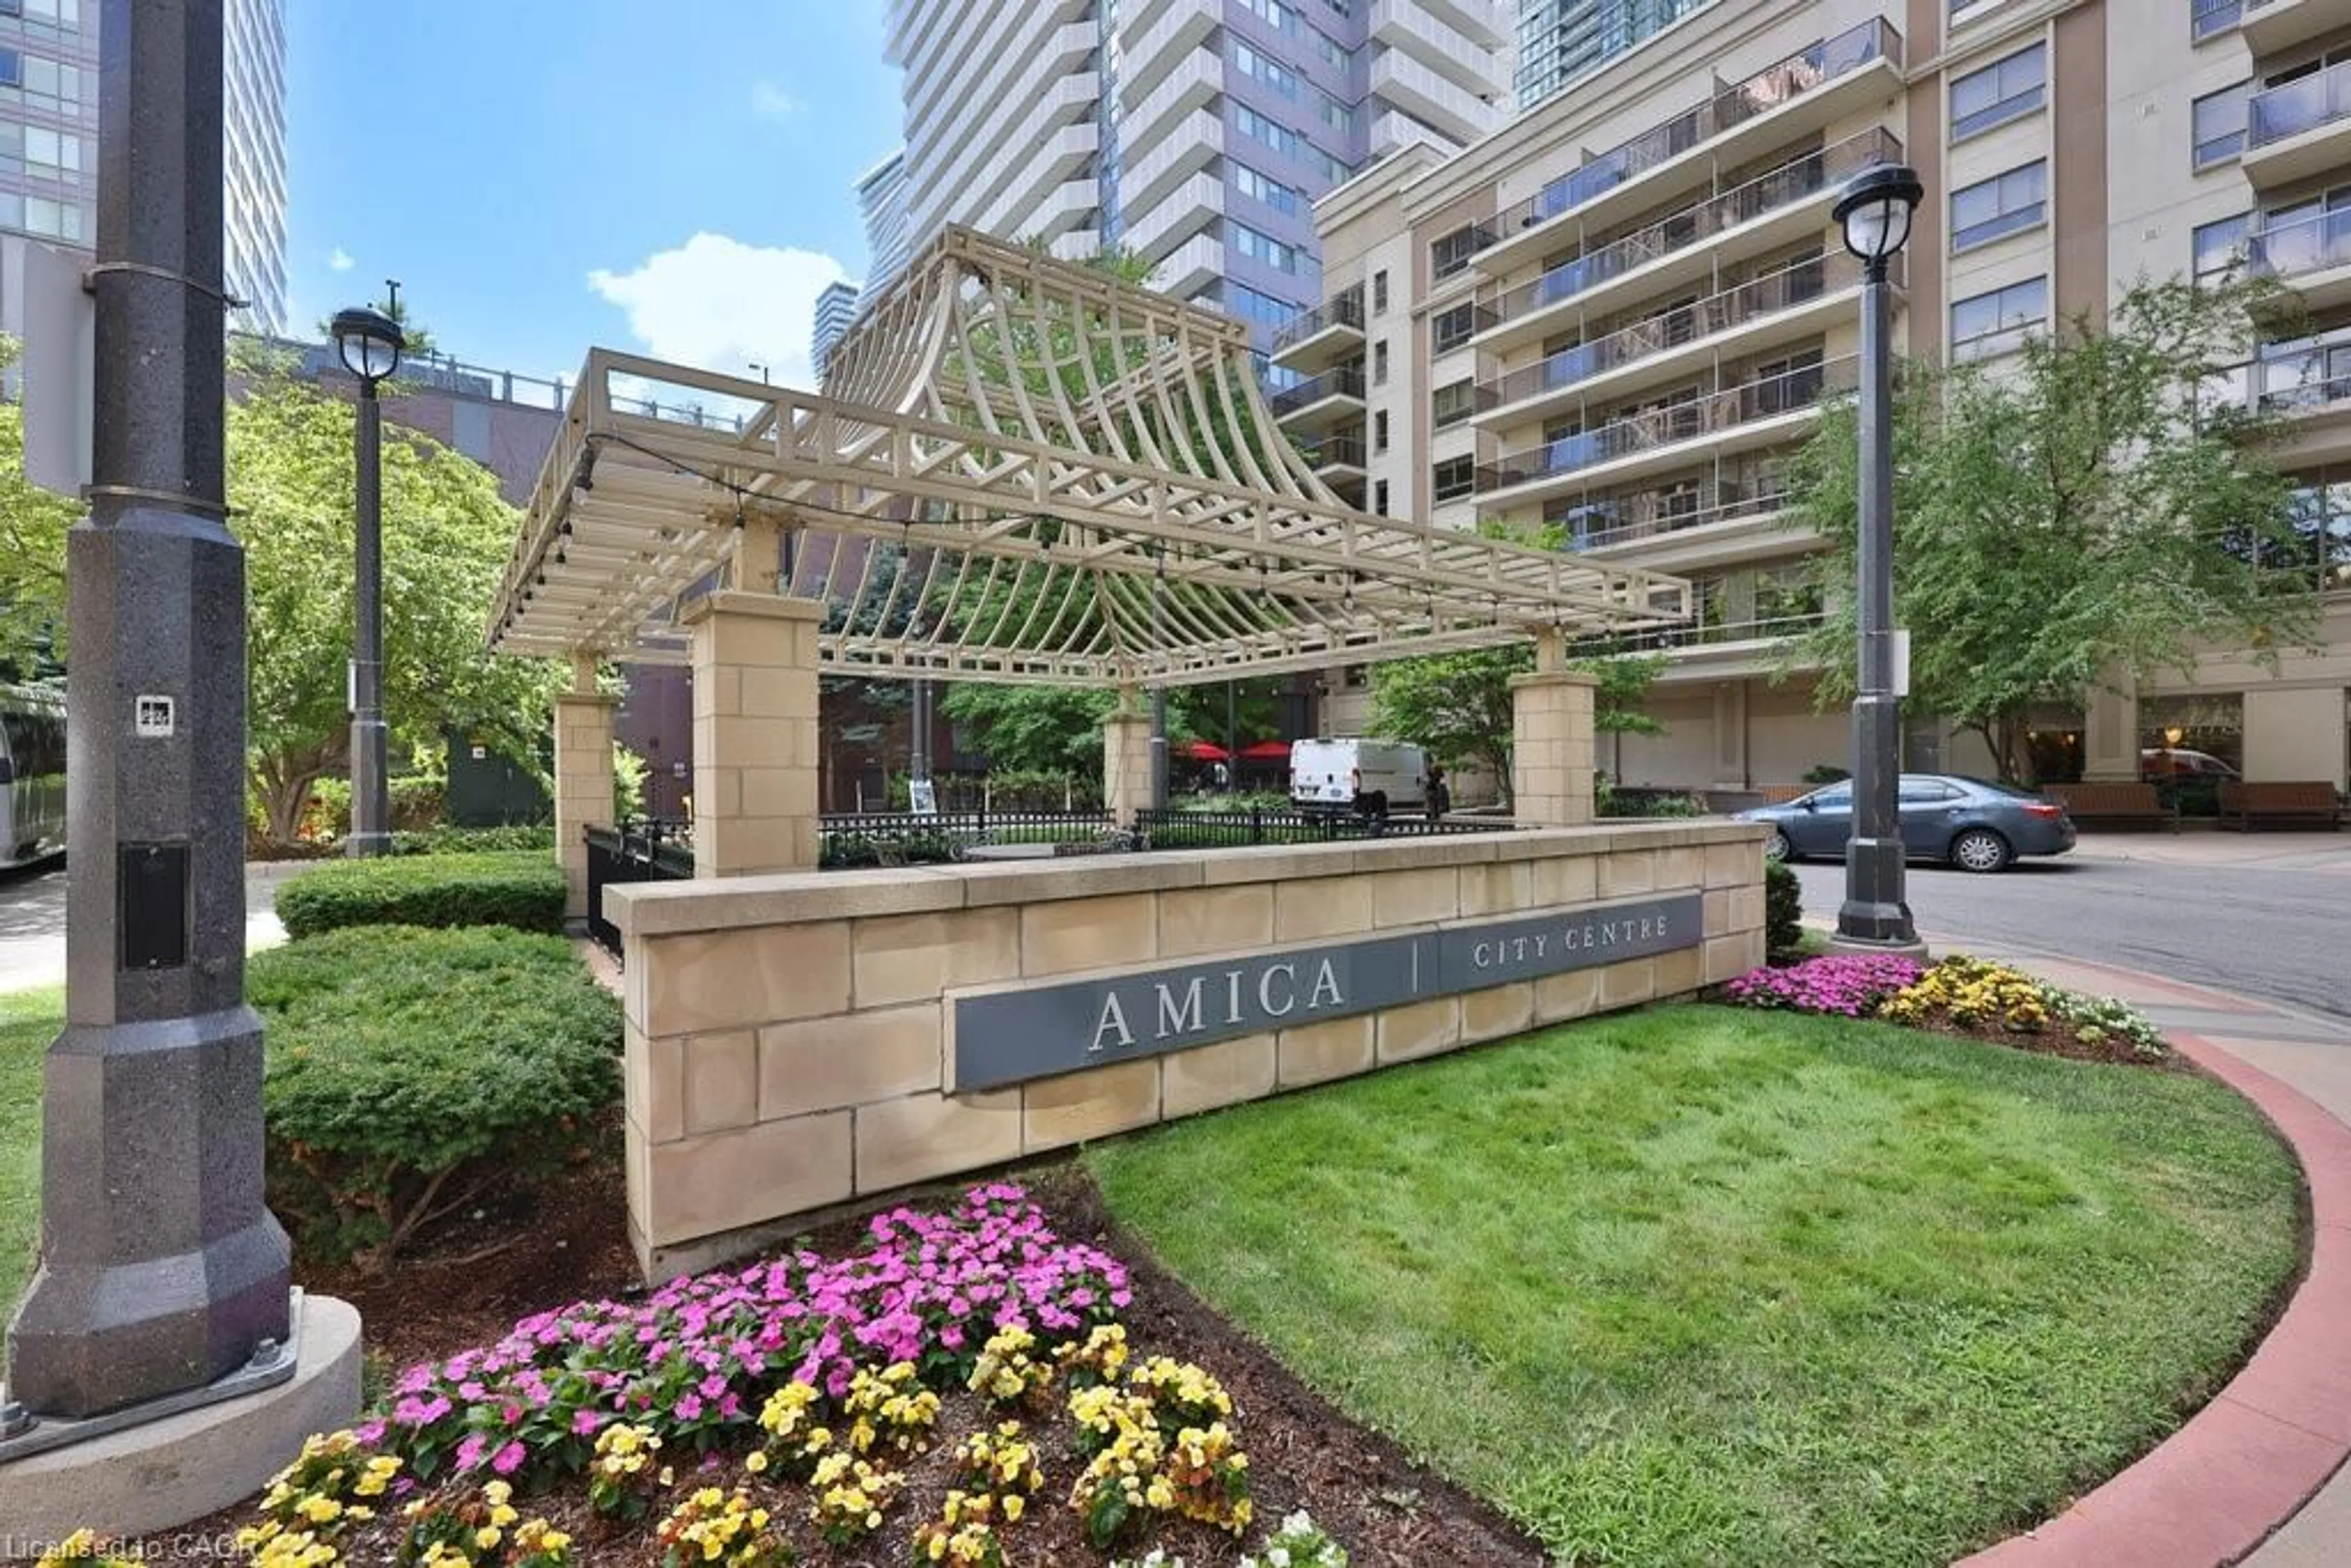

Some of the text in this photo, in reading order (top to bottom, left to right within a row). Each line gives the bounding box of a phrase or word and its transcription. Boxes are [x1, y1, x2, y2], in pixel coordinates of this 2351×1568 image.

[1088, 916, 1668, 1051] AMICA CITY CENTRE
